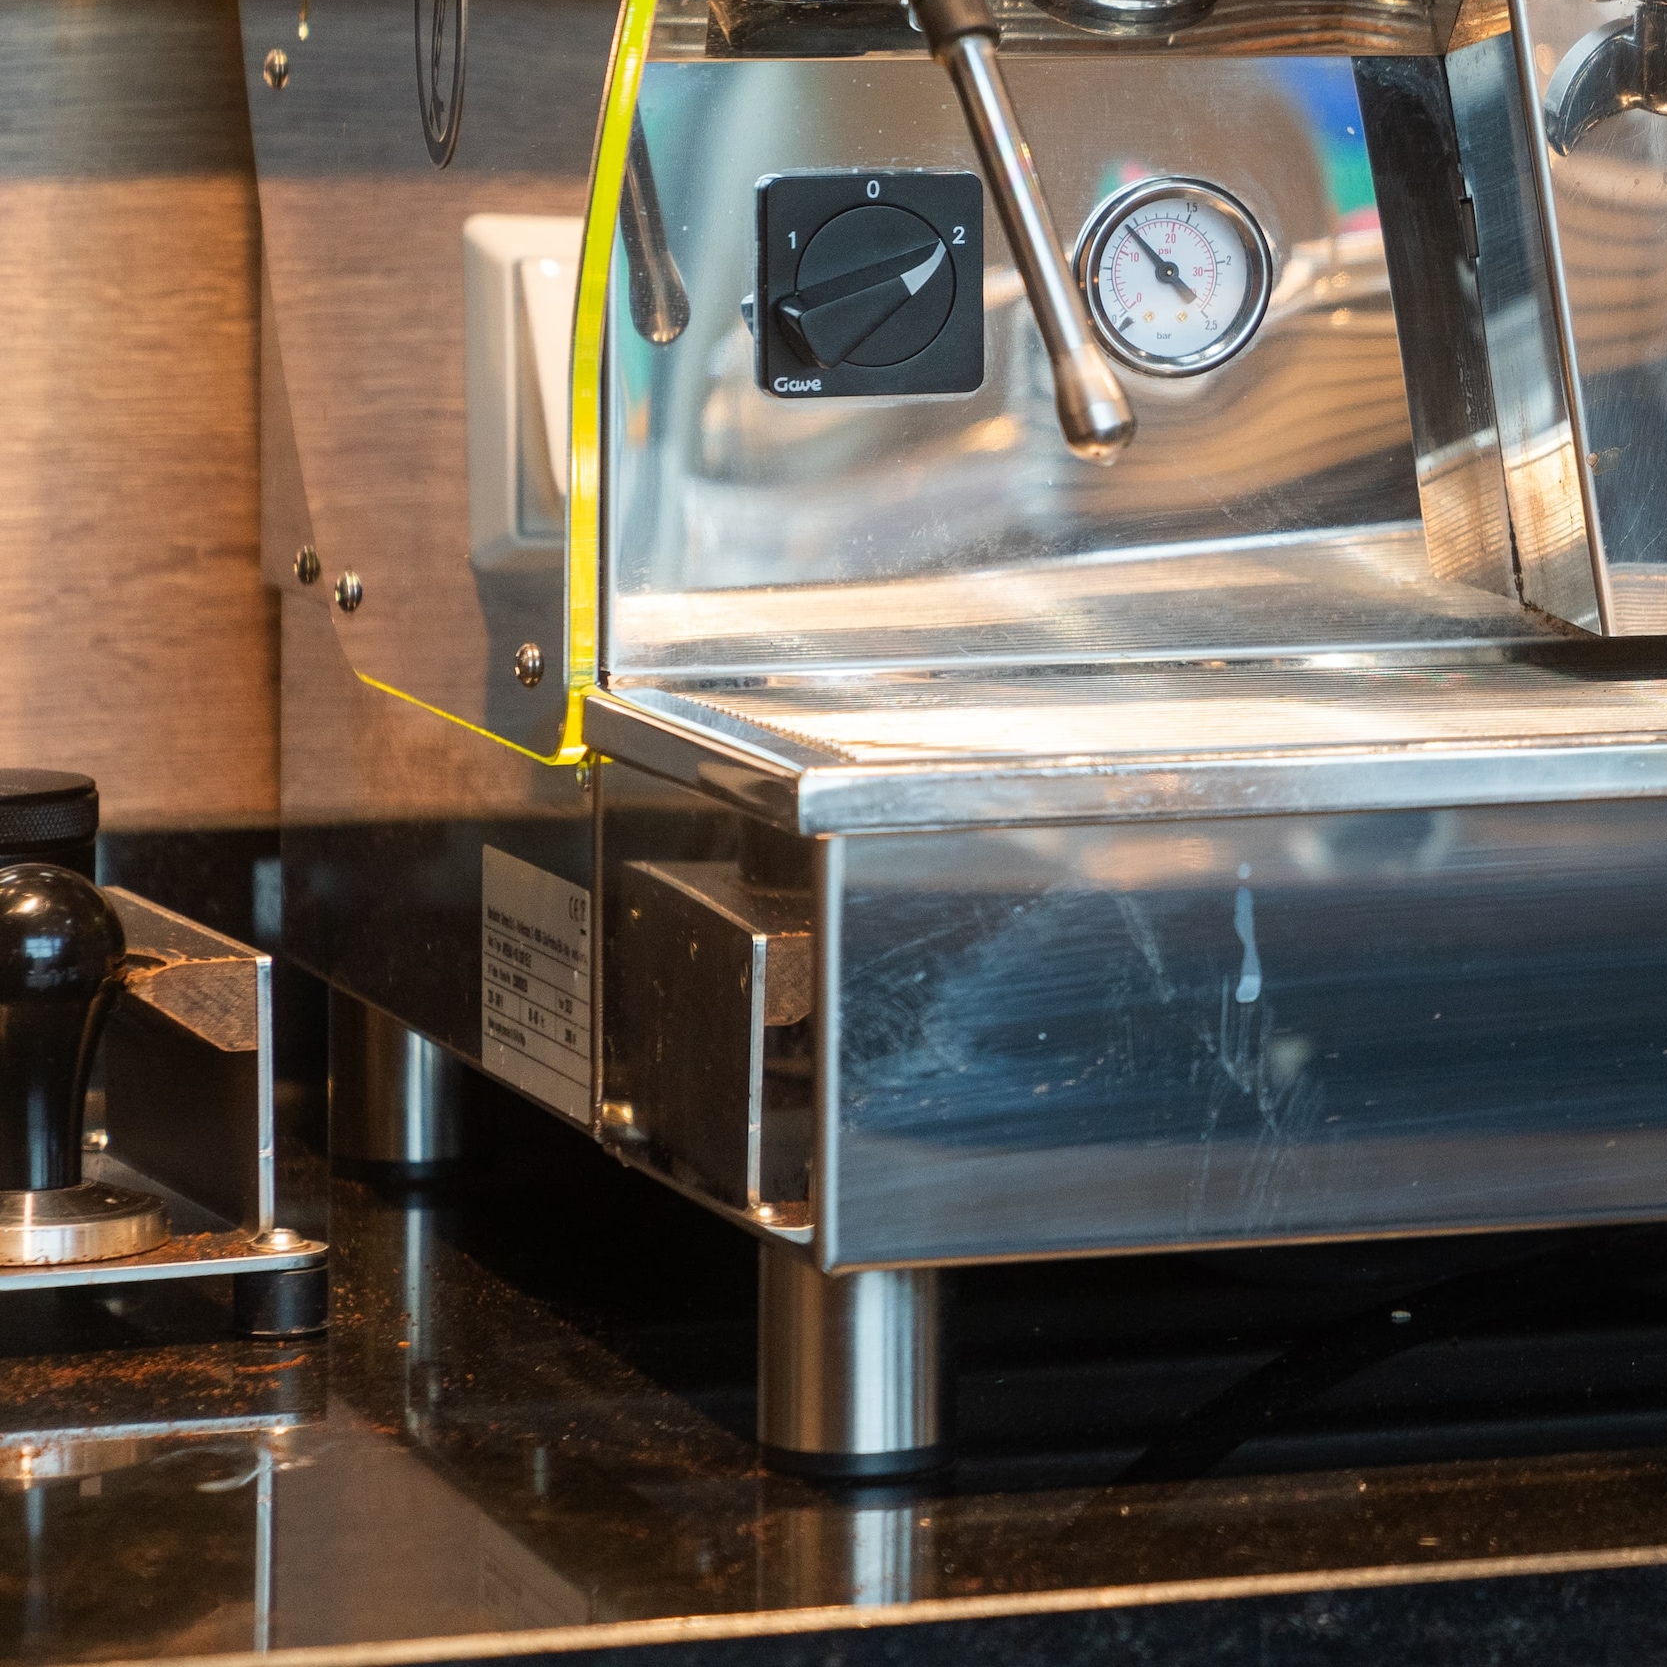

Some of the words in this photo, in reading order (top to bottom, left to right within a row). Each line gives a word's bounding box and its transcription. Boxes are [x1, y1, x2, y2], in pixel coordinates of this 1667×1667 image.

[866, 180, 880, 199] 0
[1186, 202, 1198, 213] 1,5
[788, 231, 797, 249] 1
[952, 226, 966, 244] 2
[1165, 233, 1176, 244] 20
[1158, 246, 1172, 255] psi
[1130, 252, 1140, 263] 10
[1226, 255, 1232, 266] 2
[1192, 267, 1203, 277] 30
[1136, 292, 1142, 302] 0
[1204, 320, 1218, 331] 2,5
[1156, 332, 1172, 340] bar
[774, 377, 822, 393] Gave
